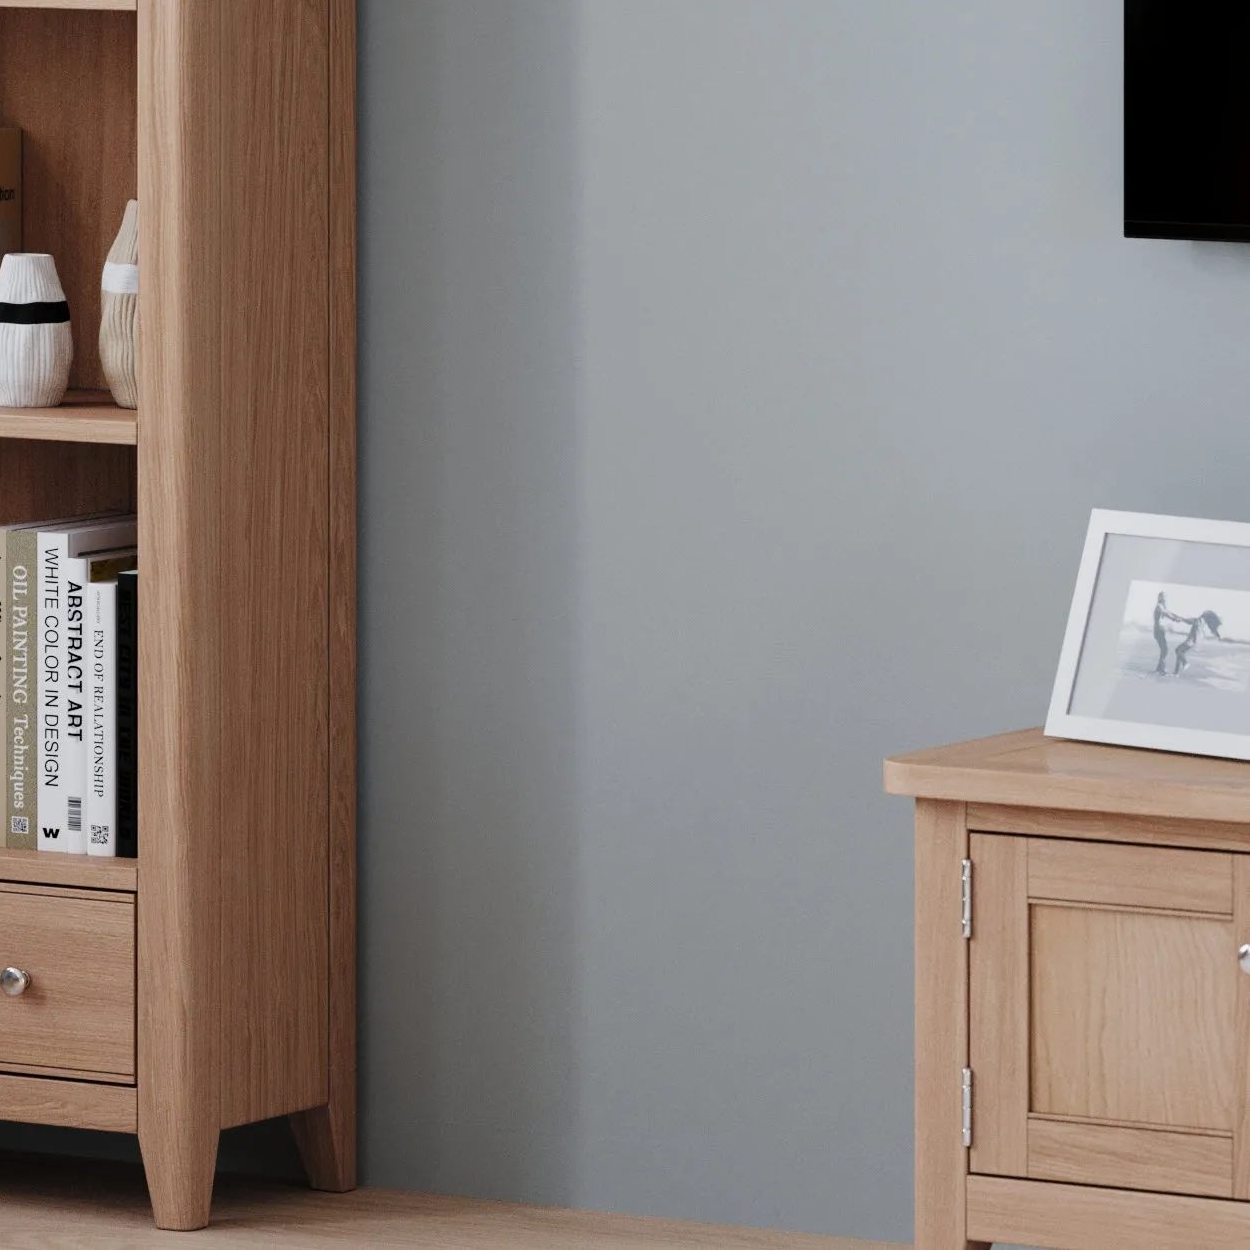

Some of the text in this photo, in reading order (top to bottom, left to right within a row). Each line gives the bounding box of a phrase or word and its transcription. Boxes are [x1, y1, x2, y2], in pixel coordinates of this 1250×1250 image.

[9, 564, 29, 809] OIL PAINTING Techniques
[44, 548, 59, 787] WHITE COLOR IN DESIGN
[68, 581, 83, 742] ABSTRACT ART
[94, 630, 104, 659] END
[94, 662, 104, 682] OF
[94, 686, 104, 798] REALATIONSHIP
